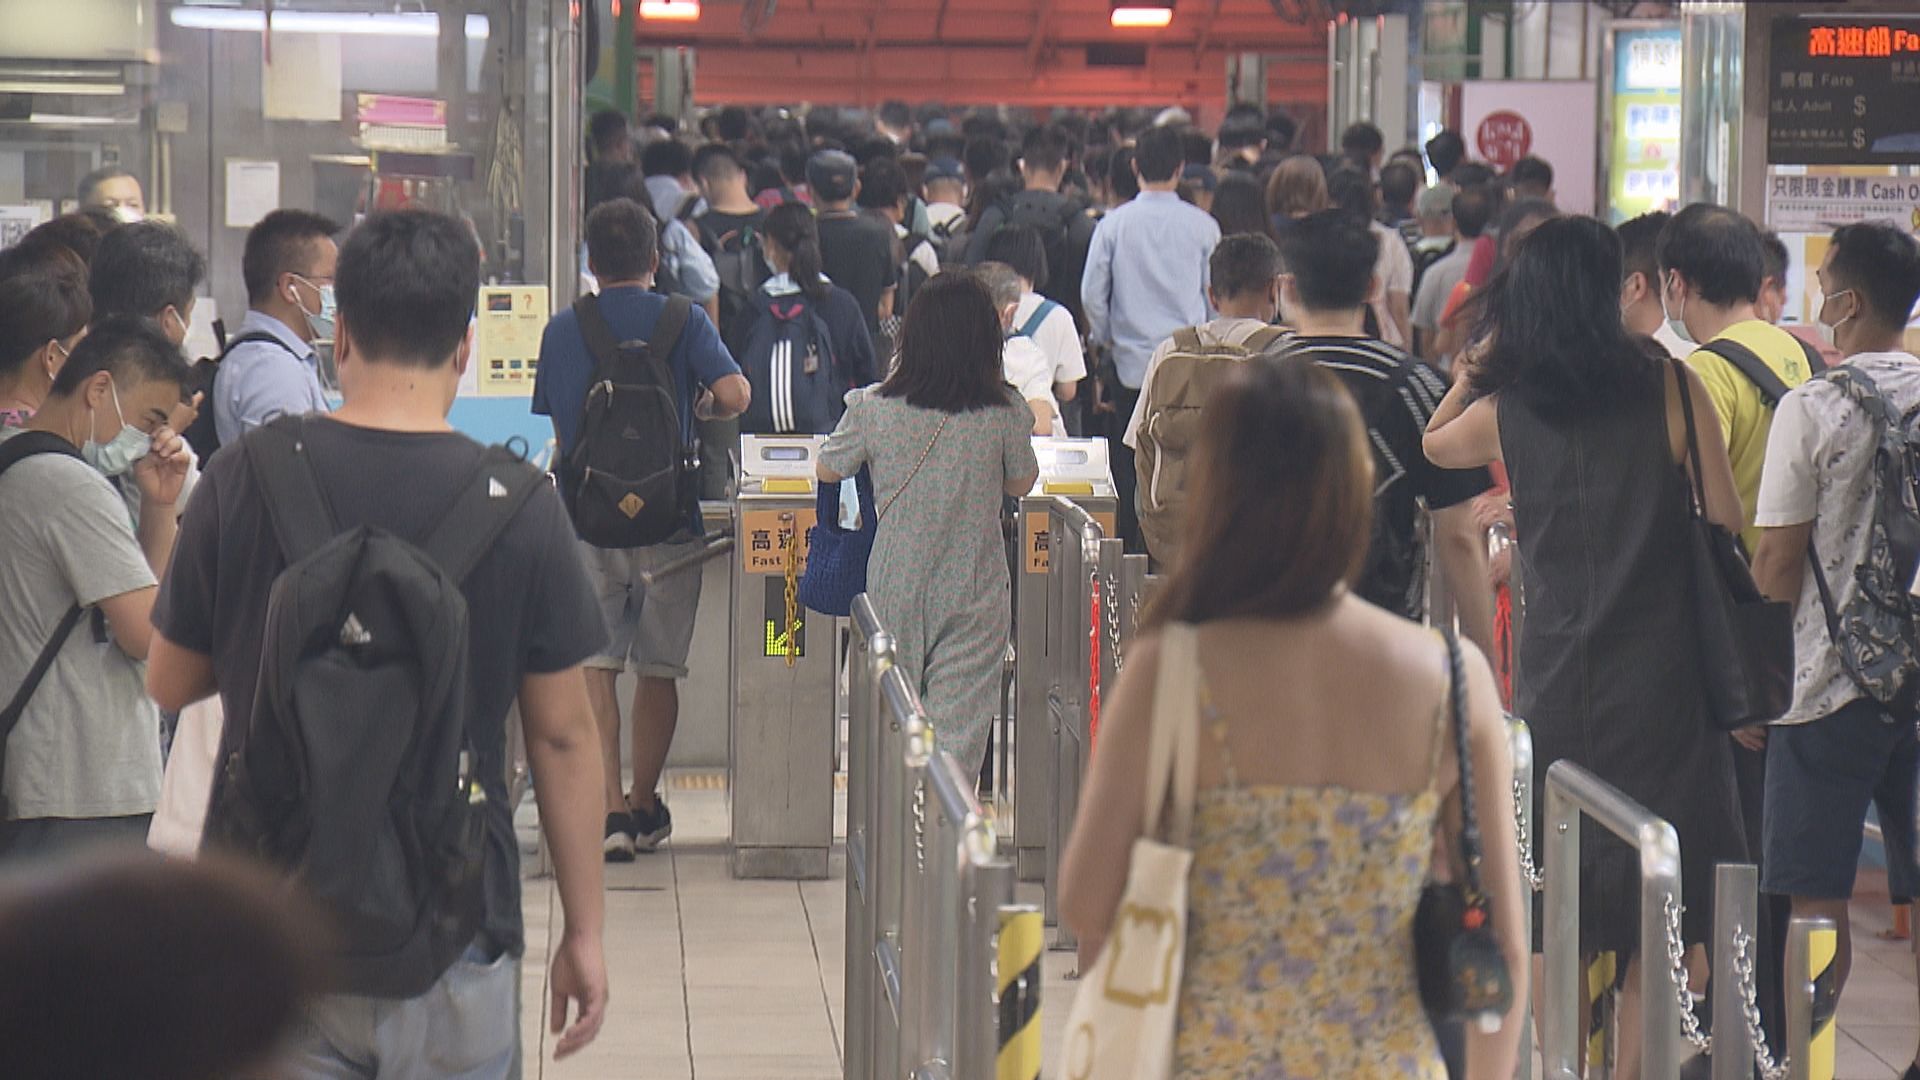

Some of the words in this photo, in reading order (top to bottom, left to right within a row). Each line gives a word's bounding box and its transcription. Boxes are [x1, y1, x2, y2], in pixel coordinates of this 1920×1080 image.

[1821, 73, 1855, 87] Fare
[1853, 95, 1867, 116] $
[1852, 127, 1866, 149] $
[1773, 176, 1868, 199] 只限現金購票
[1871, 183, 1905, 200] Cash
[752, 556, 782, 566] Fast
